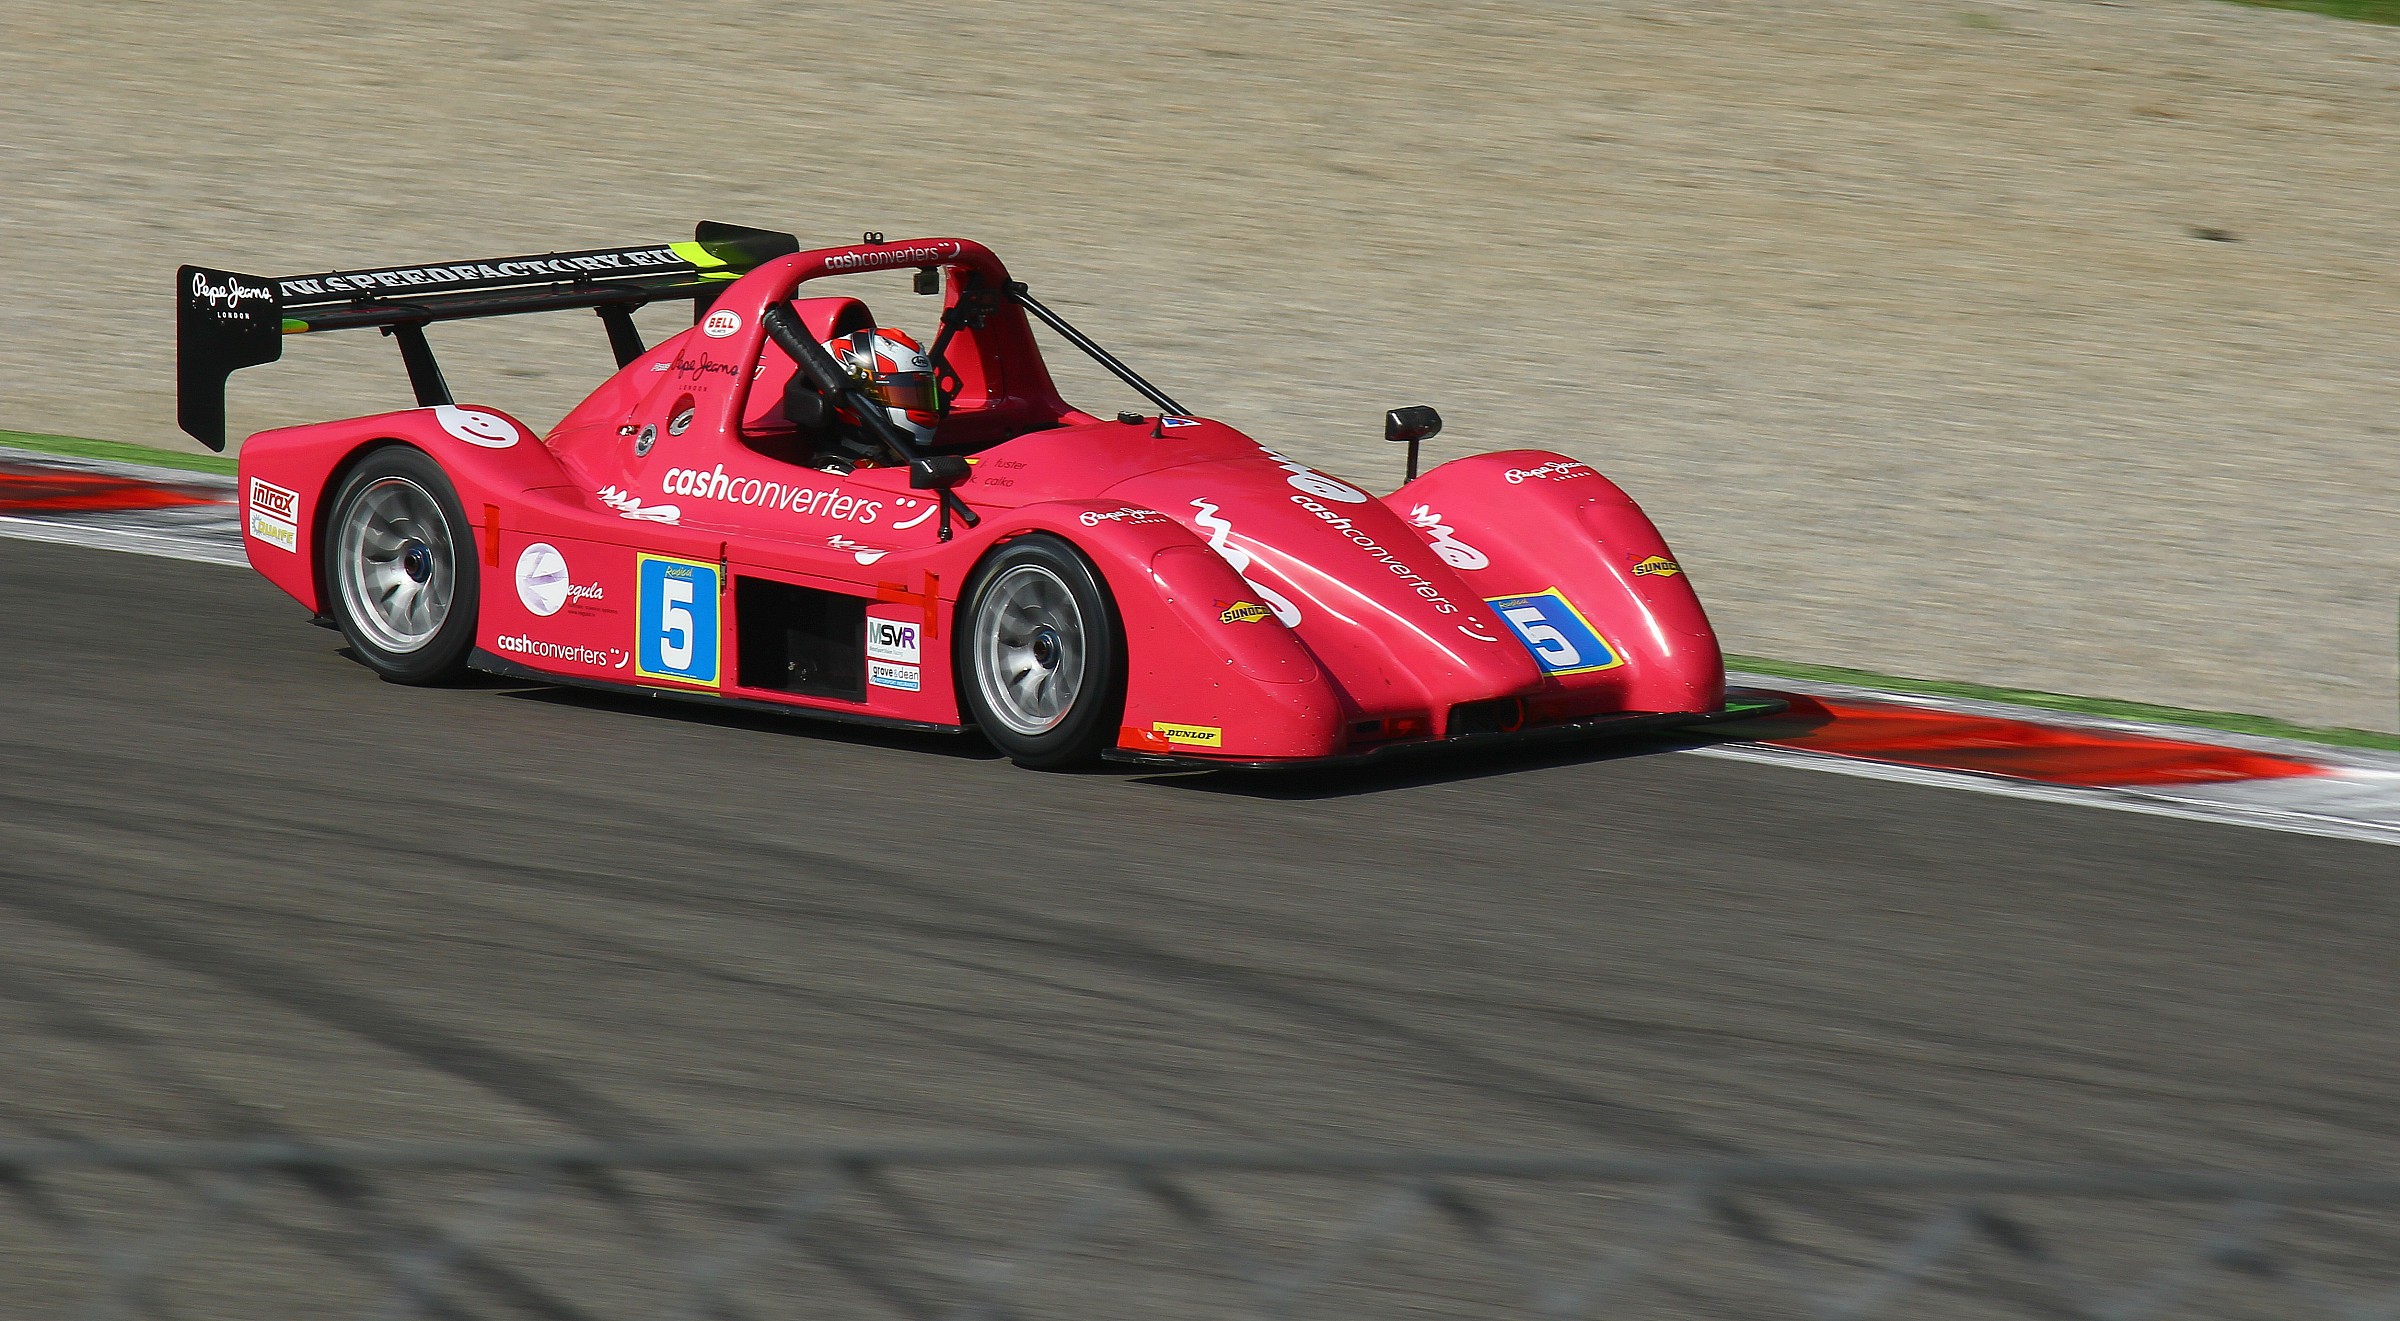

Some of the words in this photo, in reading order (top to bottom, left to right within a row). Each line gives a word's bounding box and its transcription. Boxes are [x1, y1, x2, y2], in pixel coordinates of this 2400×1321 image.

[824, 247, 939, 270] cashconverters
[192, 272, 228, 307] Pepe
[216, 311, 250, 320] LONDON
[708, 317, 734, 328] BELL
[692, 352, 738, 381] Jeans
[662, 463, 883, 525] cashconverters
[1290, 494, 1459, 615] cashconverters
[660, 577, 694, 671] 5
[869, 621, 916, 649] MSVR
[1502, 607, 1581, 667] 5
[497, 634, 607, 666] cashconverters
[1166, 729, 1216, 740] DUNLOP
